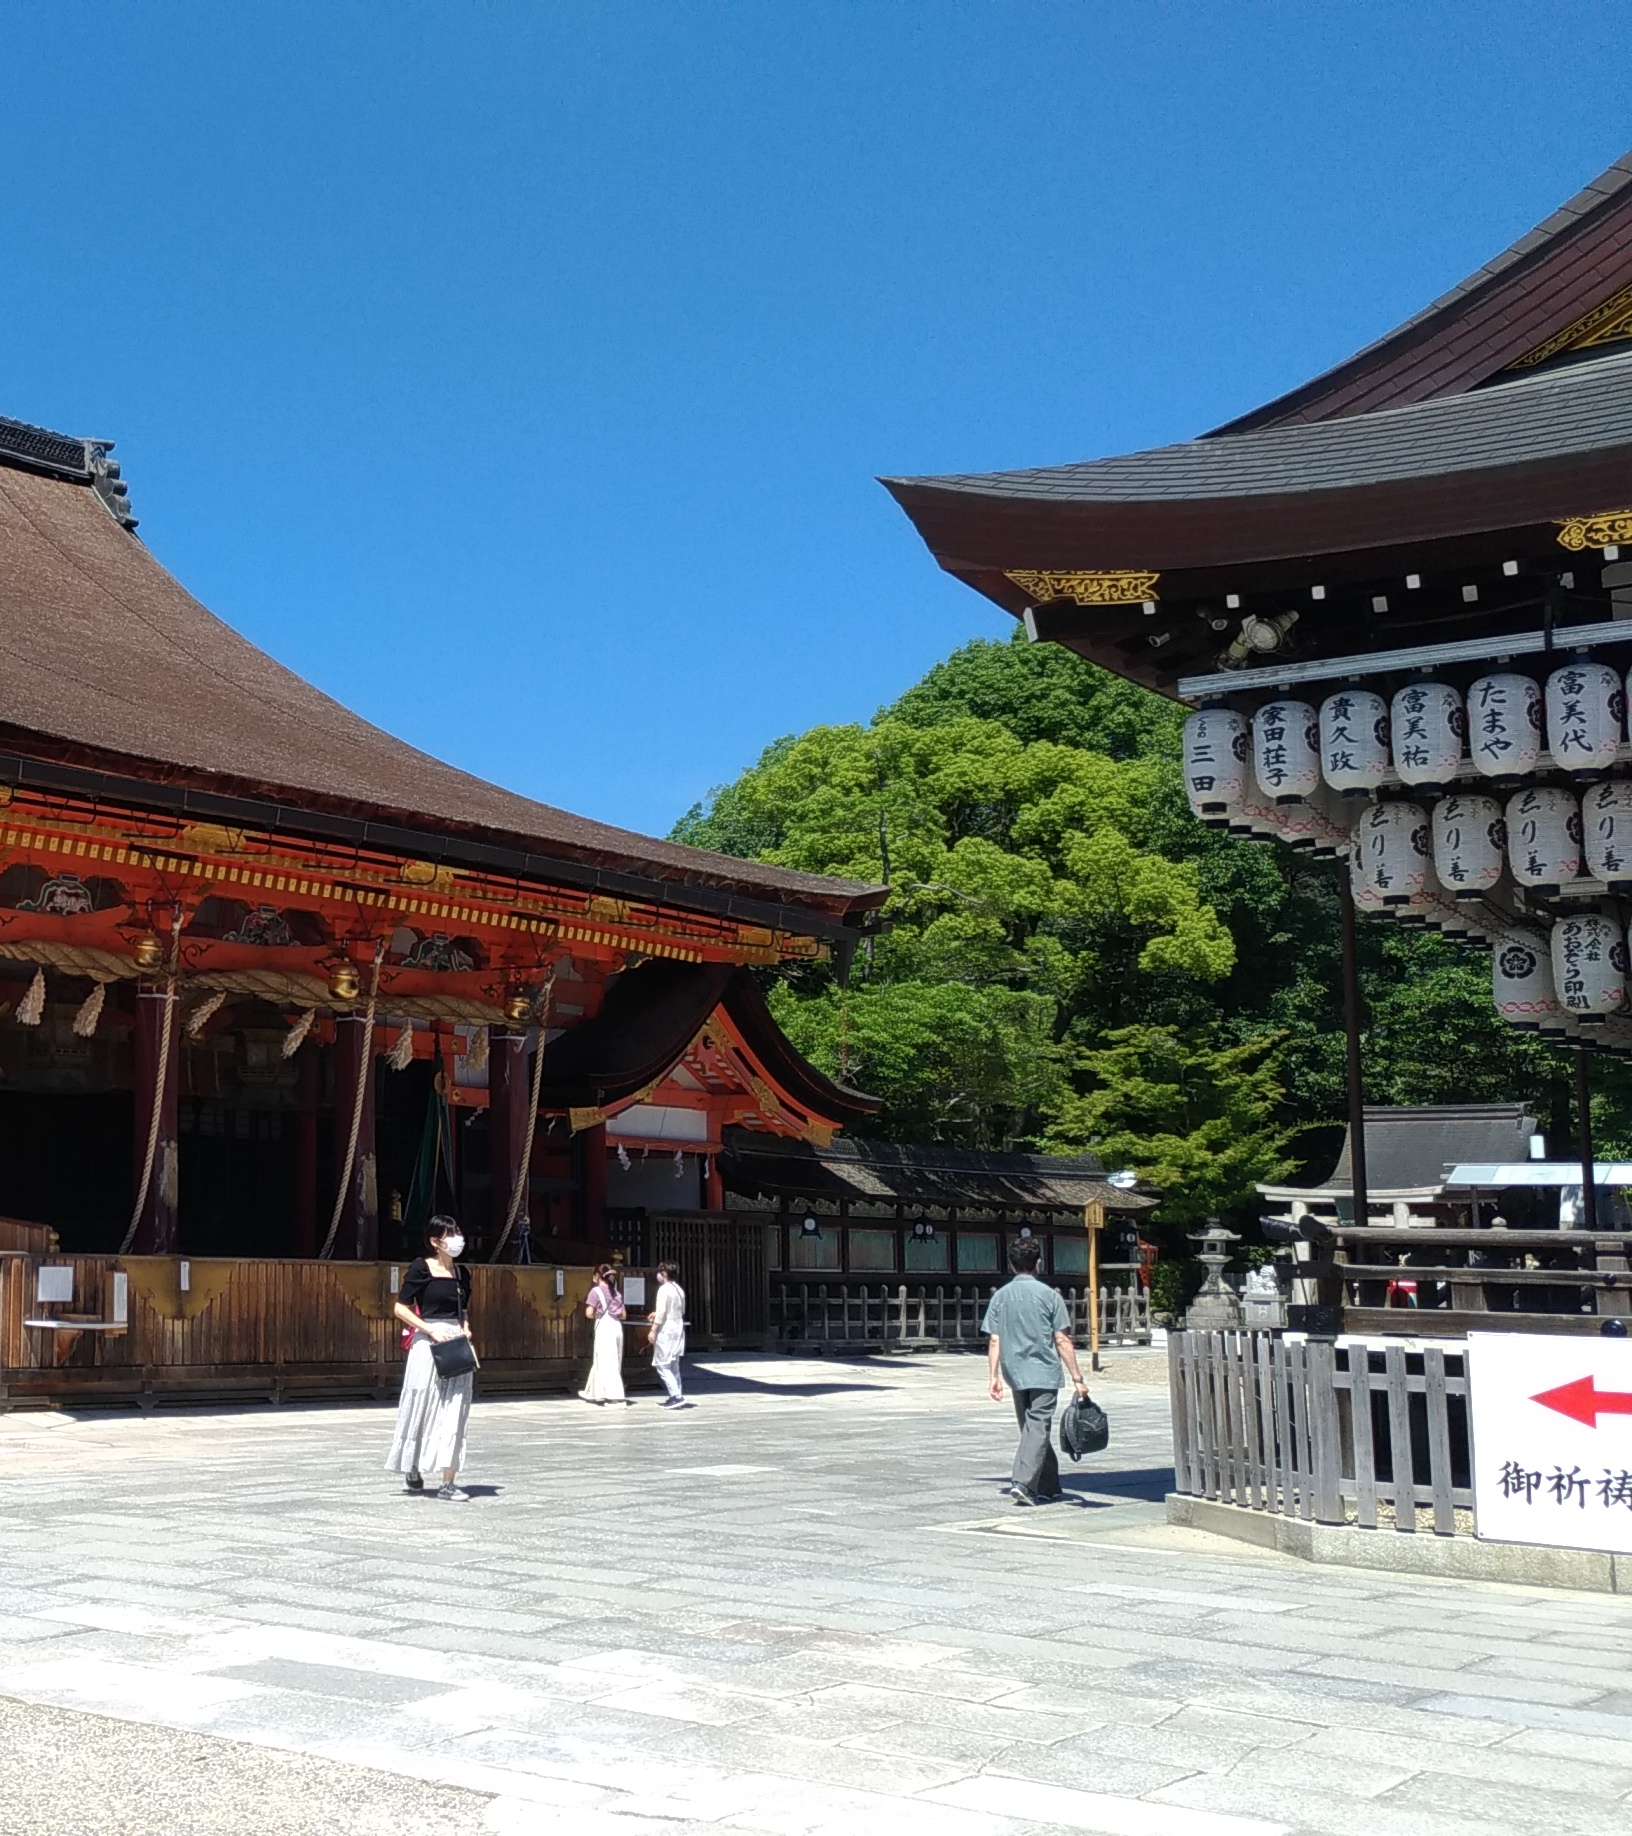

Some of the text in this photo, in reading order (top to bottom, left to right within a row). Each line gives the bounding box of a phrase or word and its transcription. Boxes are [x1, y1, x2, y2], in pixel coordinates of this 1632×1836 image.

[1260, 706, 1289, 786] 家田荘子
[1330, 696, 1359, 772] 貴久政
[1401, 690, 1430, 768] 富美祐
[1478, 682, 1514, 760] たまや
[1557, 671, 1593, 753] 富美代
[1562, 921, 1590, 1009] あおぞら印刷
[1584, 918, 1603, 962] 株式会社
[1497, 1460, 1632, 1512] 御祈祷
